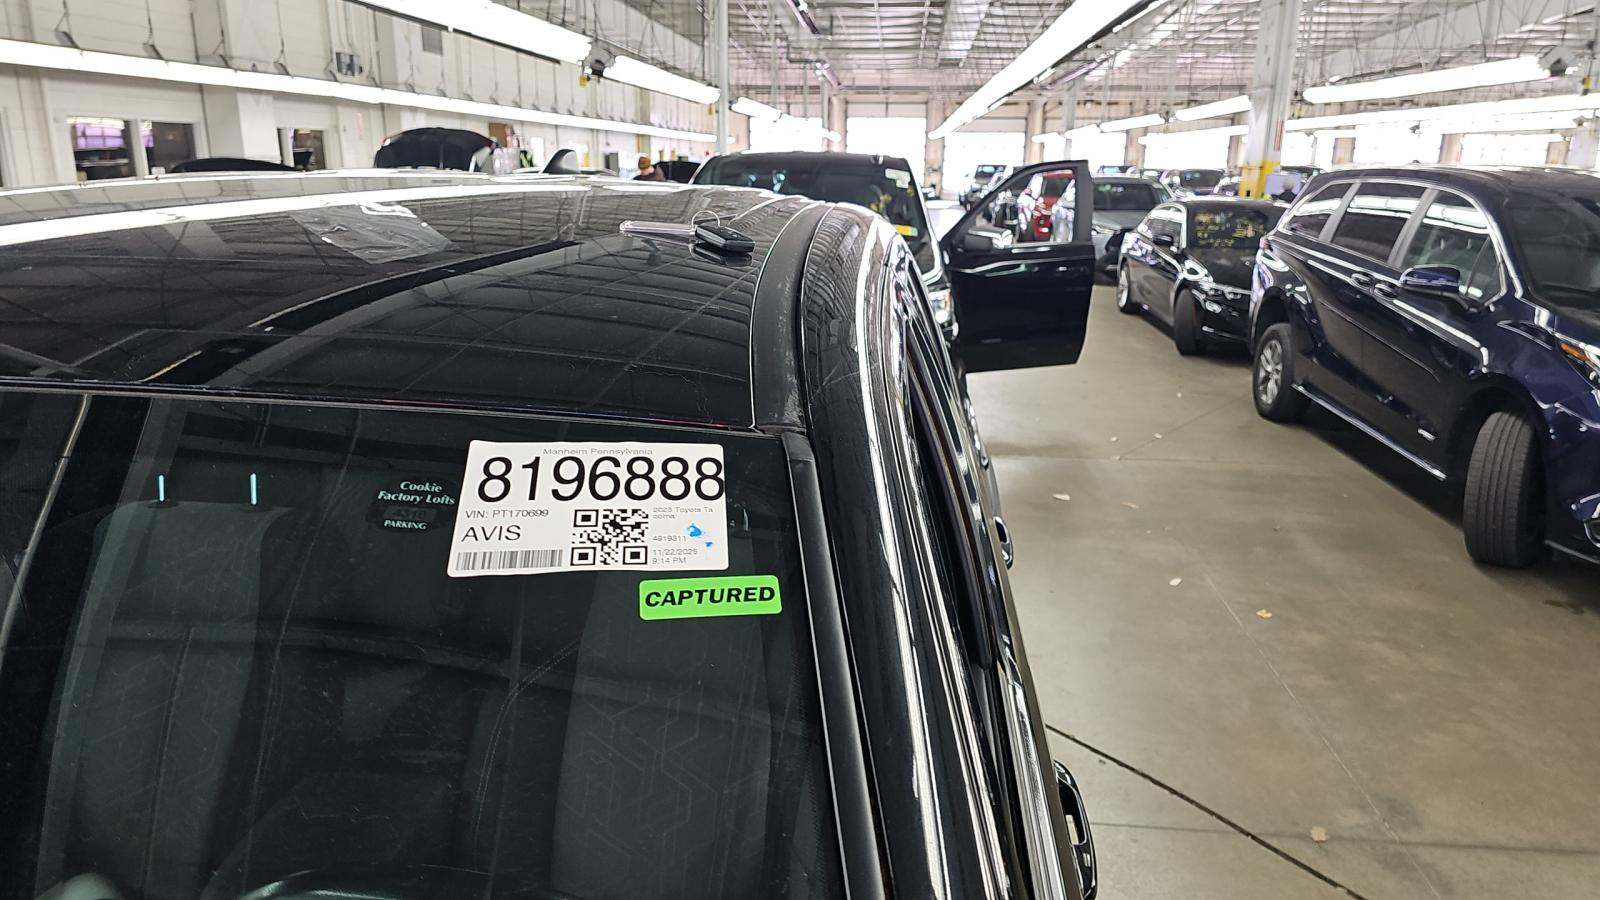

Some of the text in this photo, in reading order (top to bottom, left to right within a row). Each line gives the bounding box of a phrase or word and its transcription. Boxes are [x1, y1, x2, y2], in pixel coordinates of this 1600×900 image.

[590, 448, 653, 456] Pennsylvania
[478, 455, 725, 502] 8196888
[400, 481, 442, 493] Cookie
[377, 490, 455, 505] Factory Lofts
[465, 508, 549, 519] VIN: PT170699
[383, 520, 428, 530] PARKING
[461, 524, 521, 542] AVIS
[652, 548, 698, 556] 11/22/2025
[652, 556, 688, 565] 9:14 PM
[645, 586, 776, 608] CAPTURED
